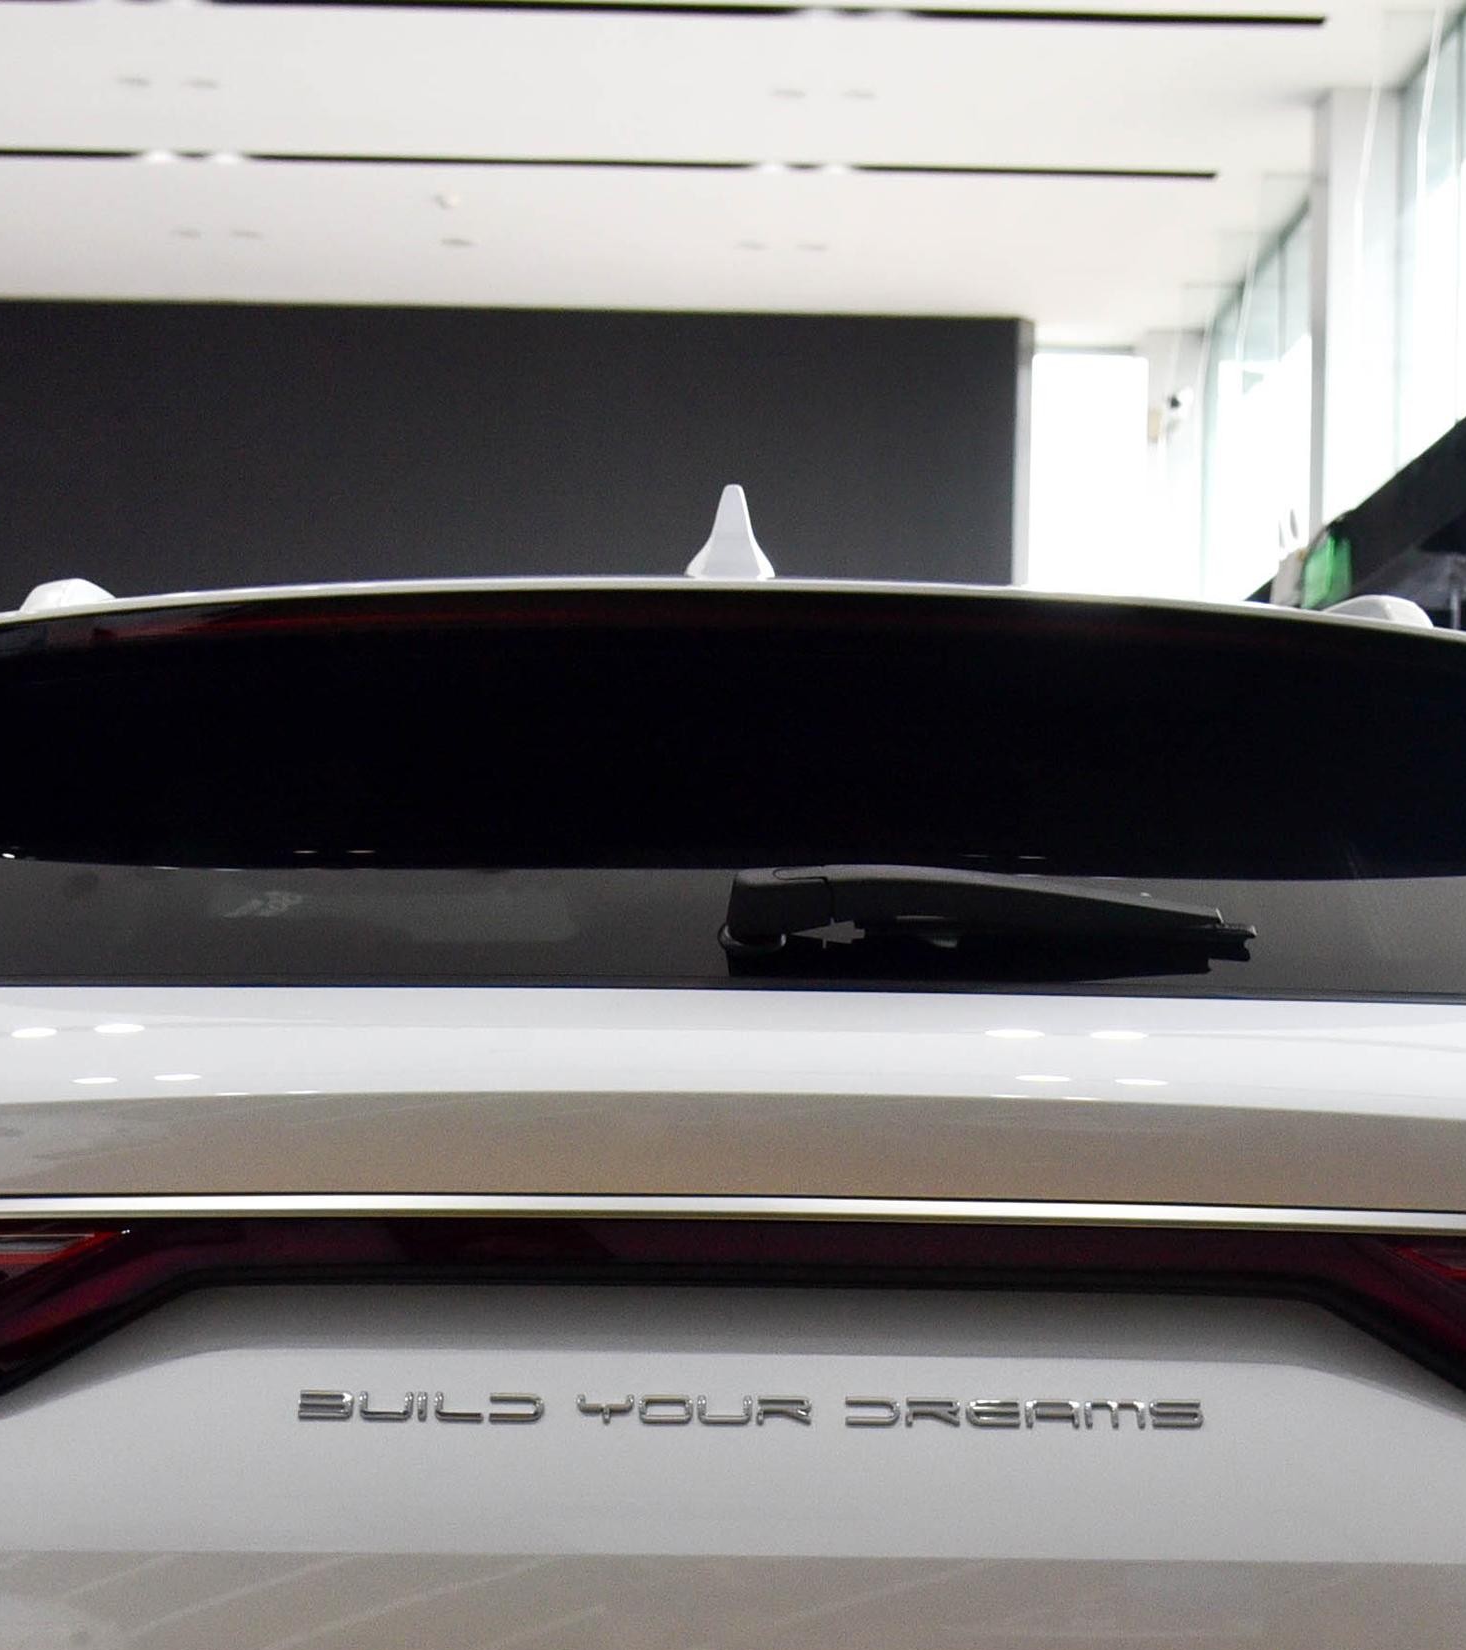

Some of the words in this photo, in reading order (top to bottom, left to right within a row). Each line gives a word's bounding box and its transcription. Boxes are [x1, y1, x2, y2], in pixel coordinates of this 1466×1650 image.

[298, 1389, 545, 1424] BUILD
[576, 1394, 813, 1426] YOUR
[844, 1395, 1205, 1430] DREAMS
